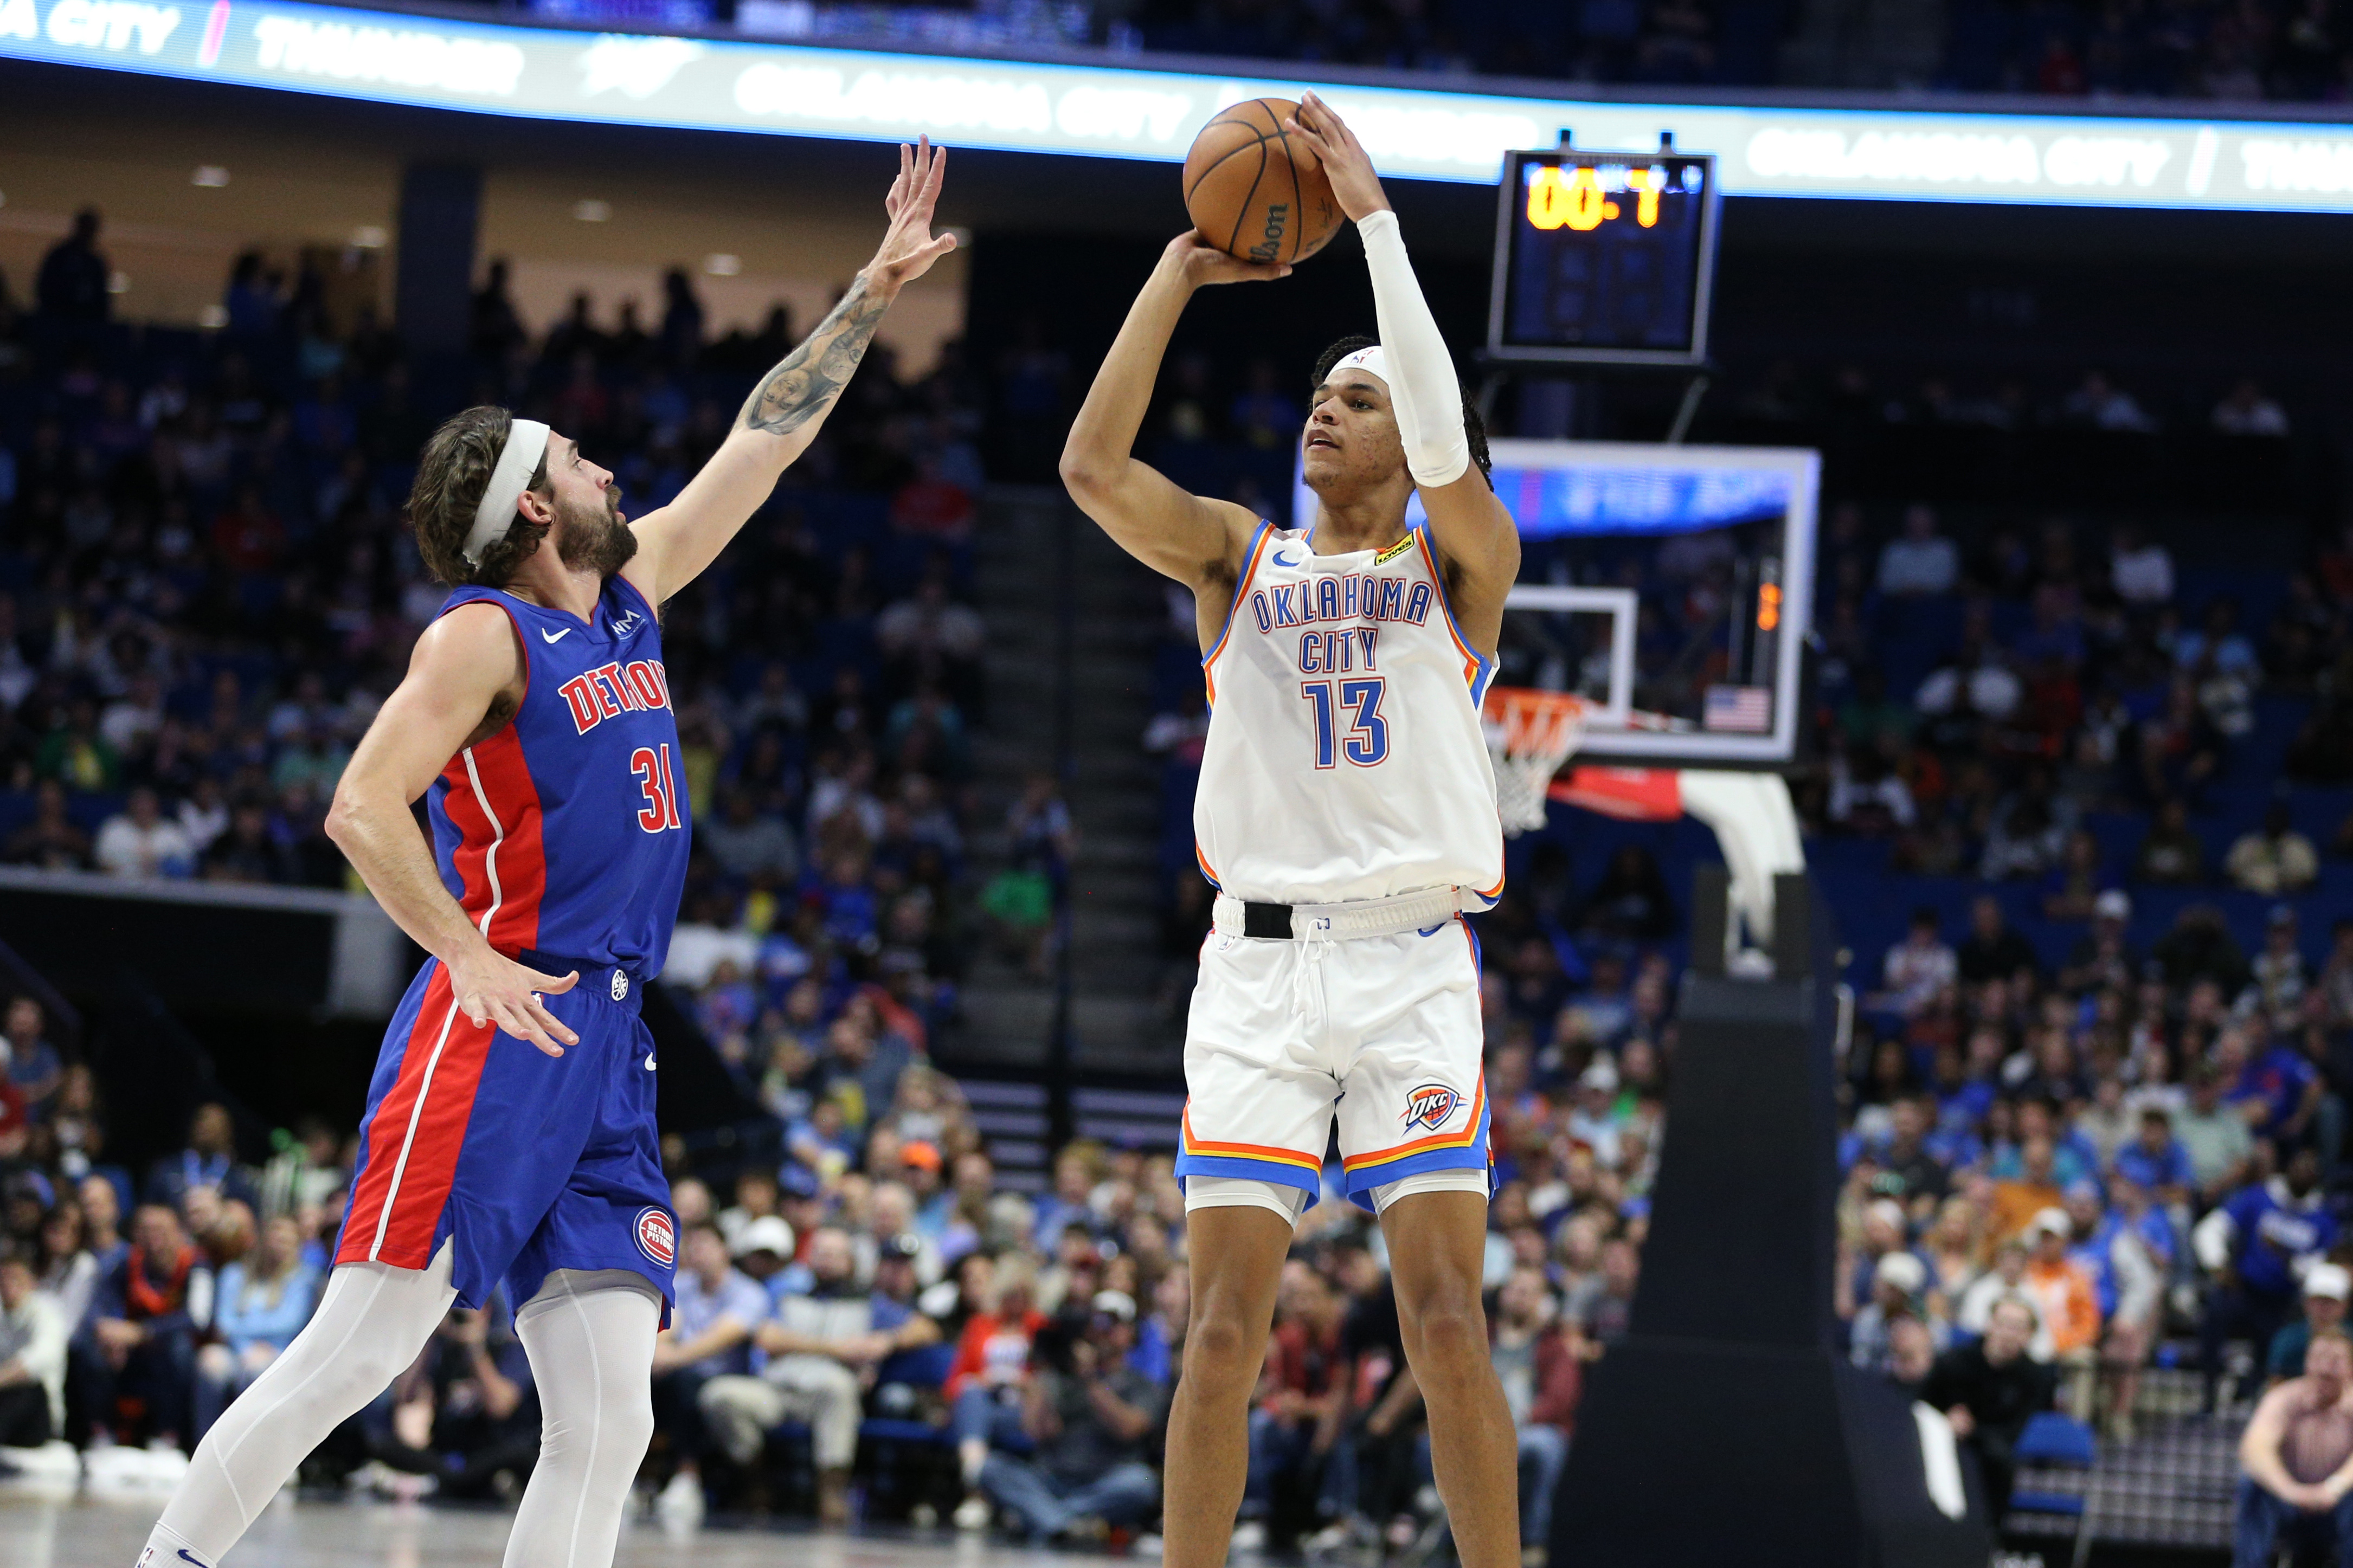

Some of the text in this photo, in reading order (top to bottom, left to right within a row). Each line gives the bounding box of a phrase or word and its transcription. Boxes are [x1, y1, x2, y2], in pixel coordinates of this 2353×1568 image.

[1251, 573, 1433, 634] OKLAHOMA
[1299, 627, 1378, 674] CITY
[1302, 677, 1390, 770] 13
[631, 743, 682, 834] 31
[1406, 1092, 1450, 1127] OKC
[646, 1230, 673, 1254] PISTONS
[647, 1221, 673, 1244] DETROIT
